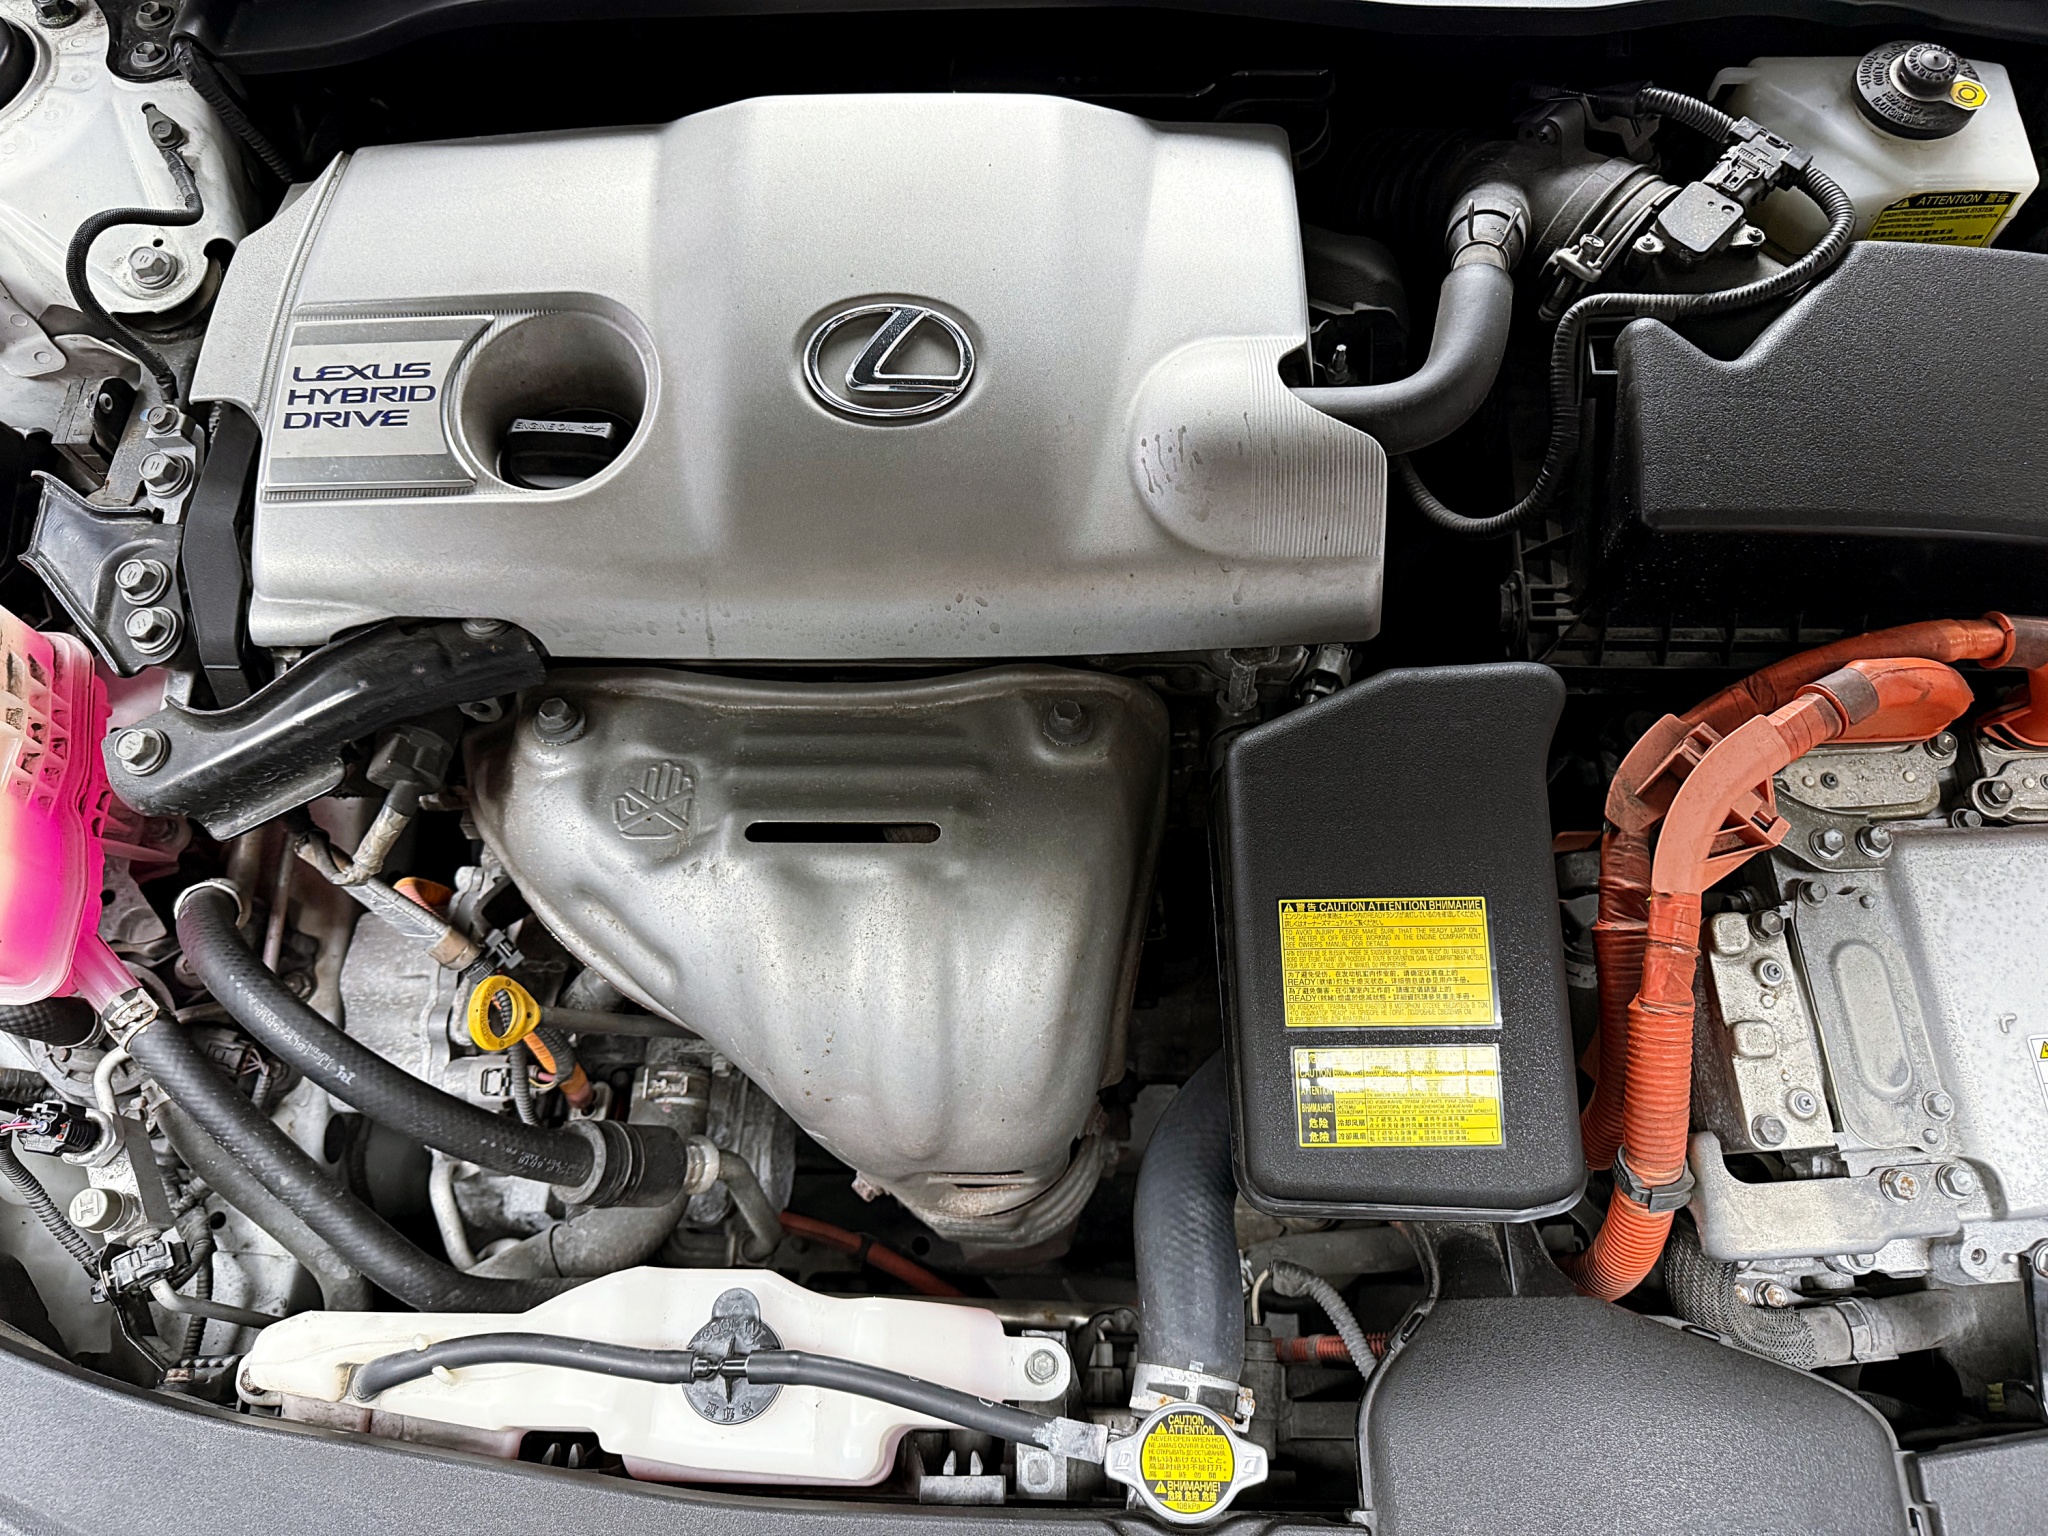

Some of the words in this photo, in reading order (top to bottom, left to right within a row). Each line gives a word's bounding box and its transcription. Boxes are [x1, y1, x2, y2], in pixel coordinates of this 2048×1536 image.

[1916, 194, 1983, 206] ATTENTION
[292, 361, 432, 382] LEXUS
[287, 385, 437, 406] HYBRID
[283, 409, 411, 430] DRIVE
[515, 422, 555, 431] ENGINE
[558, 423, 575, 432] OIL
[1319, 902, 1365, 912] CAUTION
[1368, 901, 1426, 911] ATTENTION
[1429, 900, 1481, 910] ВНИМАНИЕ
[1168, 1414, 1204, 1425] CAUTION
[1168, 1424, 1215, 1435] ATTENTION
[1167, 1480, 1221, 1492] ВНИМАНИЕ!
[1176, 1502, 1201, 1510] 108kPa
